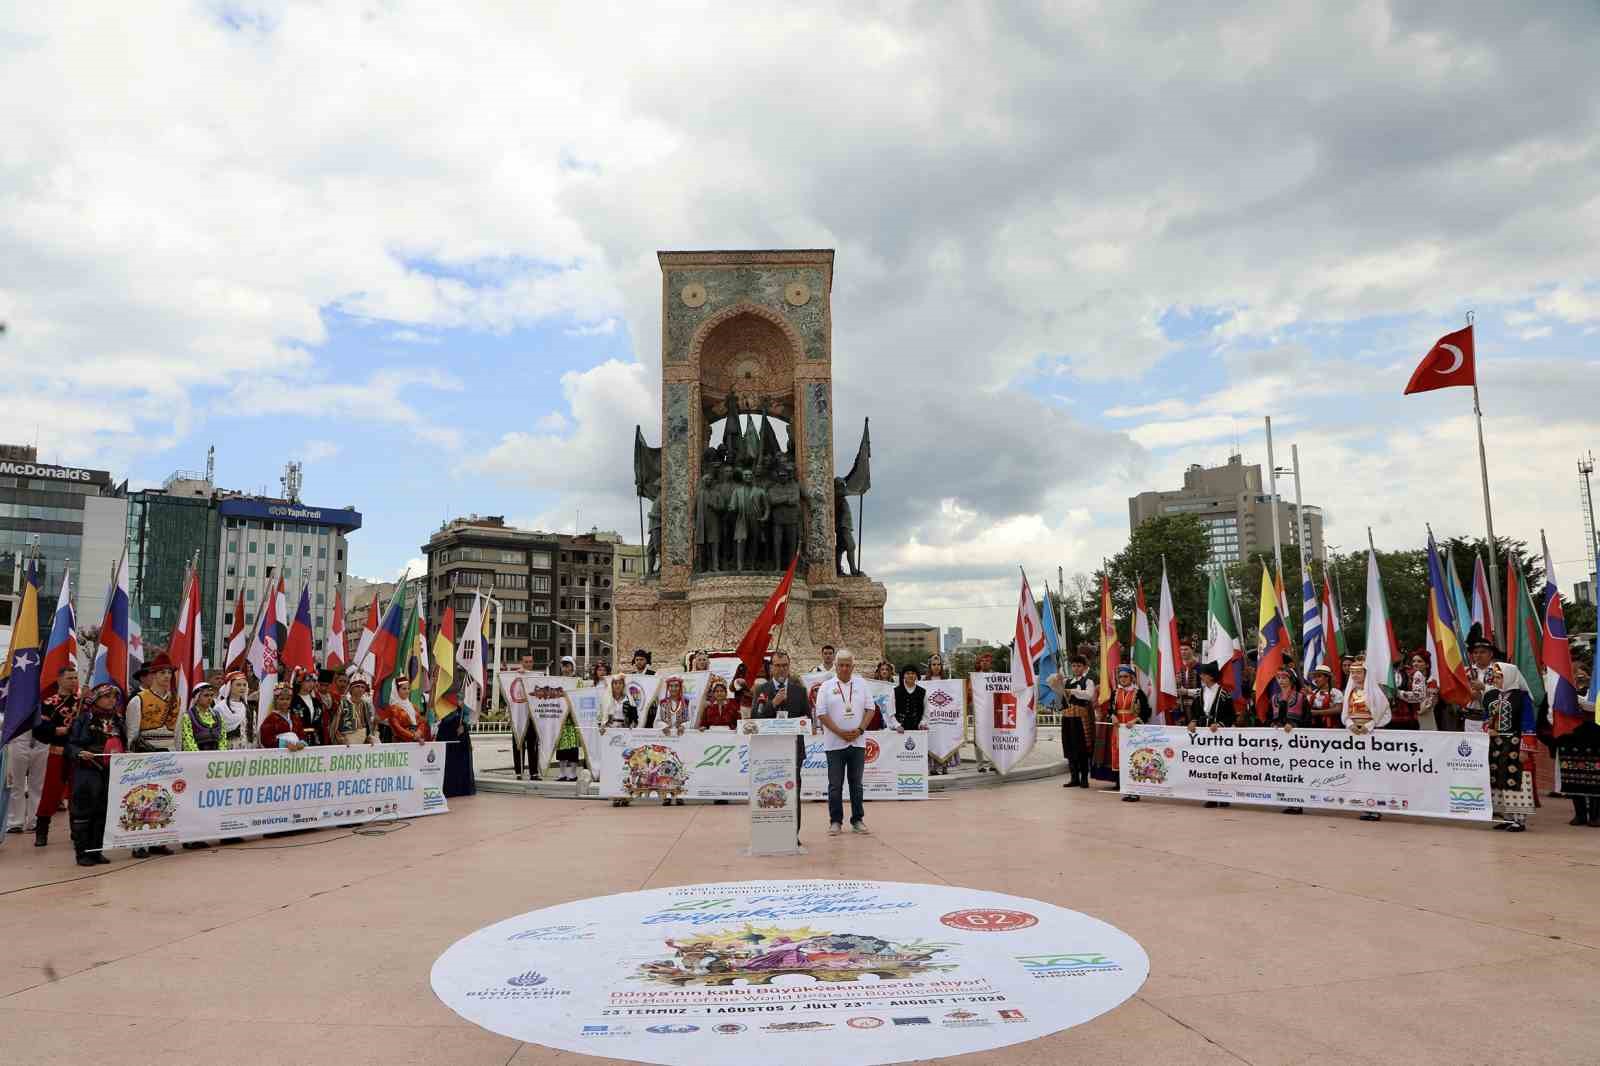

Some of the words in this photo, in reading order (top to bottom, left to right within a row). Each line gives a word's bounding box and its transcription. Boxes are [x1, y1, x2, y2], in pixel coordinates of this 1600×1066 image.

[0, 462, 91, 481] McDonald's
[695, 744, 737, 768] 27.
[1188, 733, 1234, 746] Yurtta
[1238, 734, 1284, 751] barış,
[1288, 734, 1366, 753] dünyada
[1371, 736, 1424, 757] barış.
[206, 757, 247, 779] SEVGİ
[330, 754, 363, 773] BARIŞ
[1181, 750, 1220, 765] Peace
[1223, 752, 1237, 765] at
[1241, 752, 1285, 769] home,
[1289, 756, 1335, 771] peace
[1339, 756, 1353, 770] in
[1358, 757, 1381, 771] the
[1386, 759, 1439, 775] world.
[1188, 769, 1230, 783] Mustafa
[1231, 771, 1263, 781] Kemal
[1264, 773, 1305, 784] Atatürk
[198, 788, 235, 809] LOVE
[237, 786, 254, 805] TO
[256, 784, 291, 804] EACH
[293, 781, 334, 801] OTHER,
[337, 778, 373, 797] PEACE
[374, 776, 394, 793] FOR
[966, 914, 1009, 925] 62
[890, 998, 945, 1006] AUGUST
